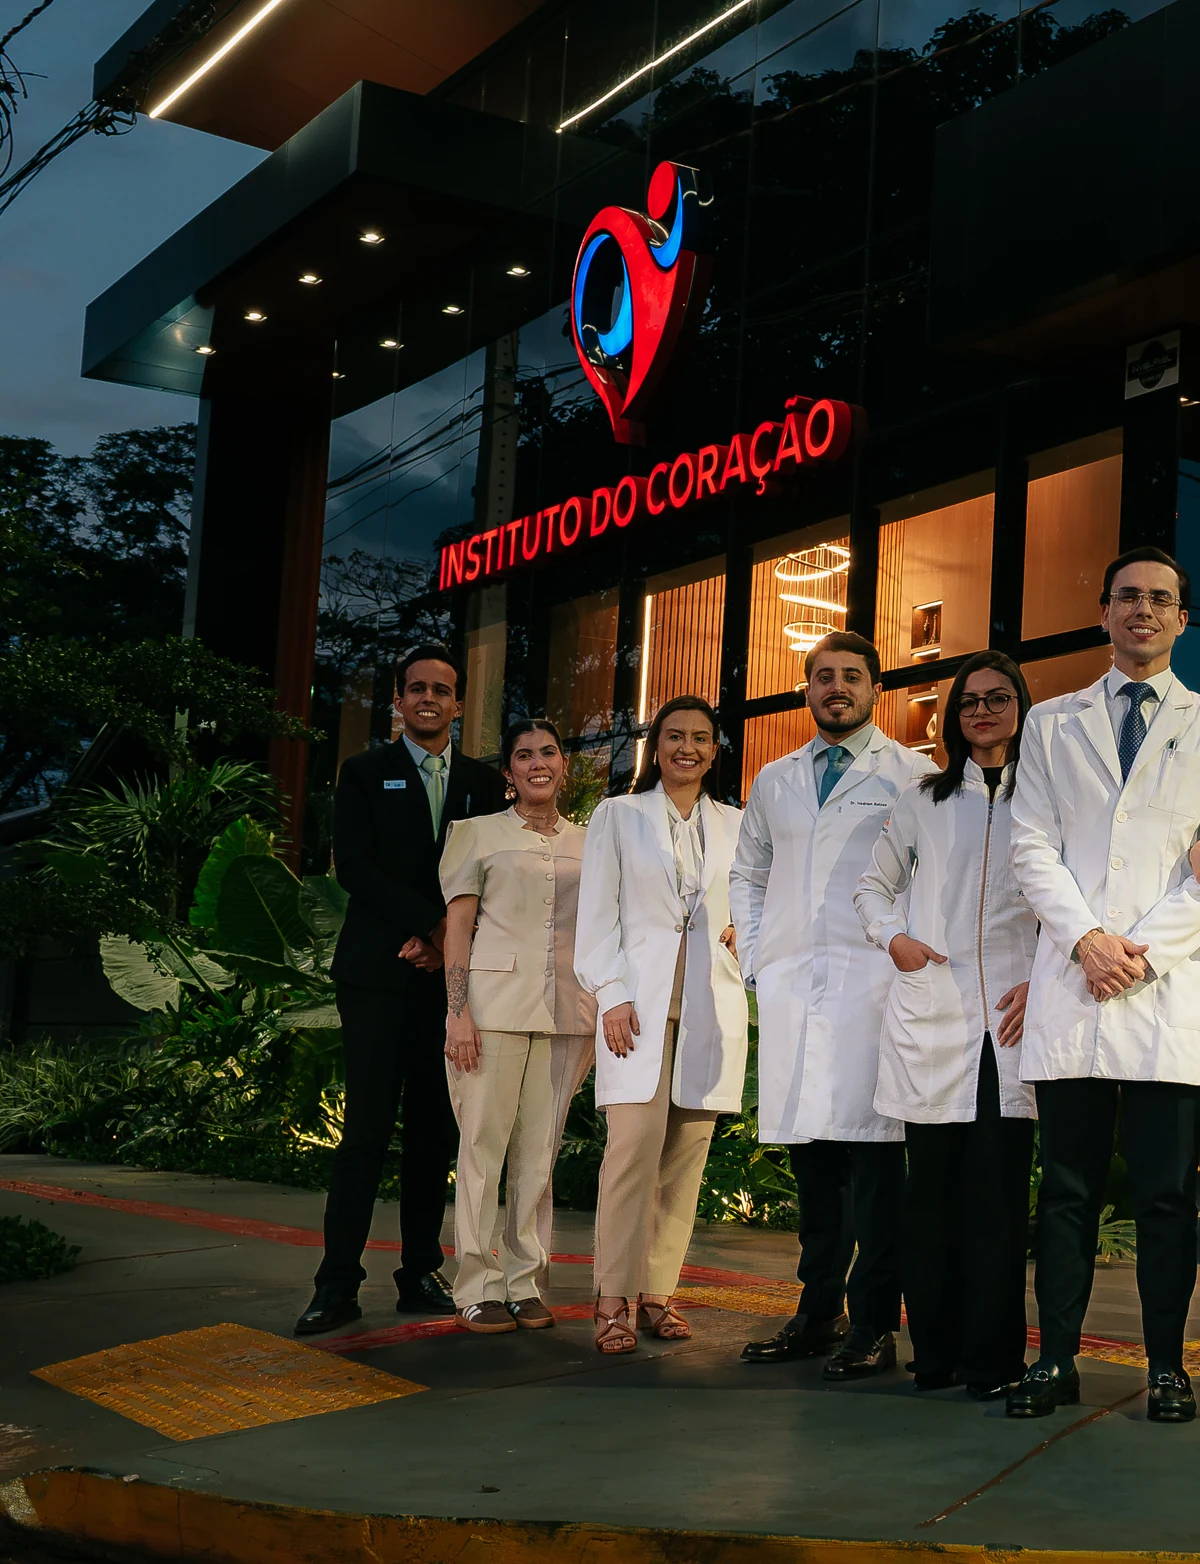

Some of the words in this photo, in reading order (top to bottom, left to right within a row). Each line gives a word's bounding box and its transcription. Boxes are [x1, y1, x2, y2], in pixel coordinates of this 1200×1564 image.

[438, 496, 583, 592] INSTITUTO
[590, 475, 638, 538] DO
[646, 395, 836, 516] CORAÇÃO
